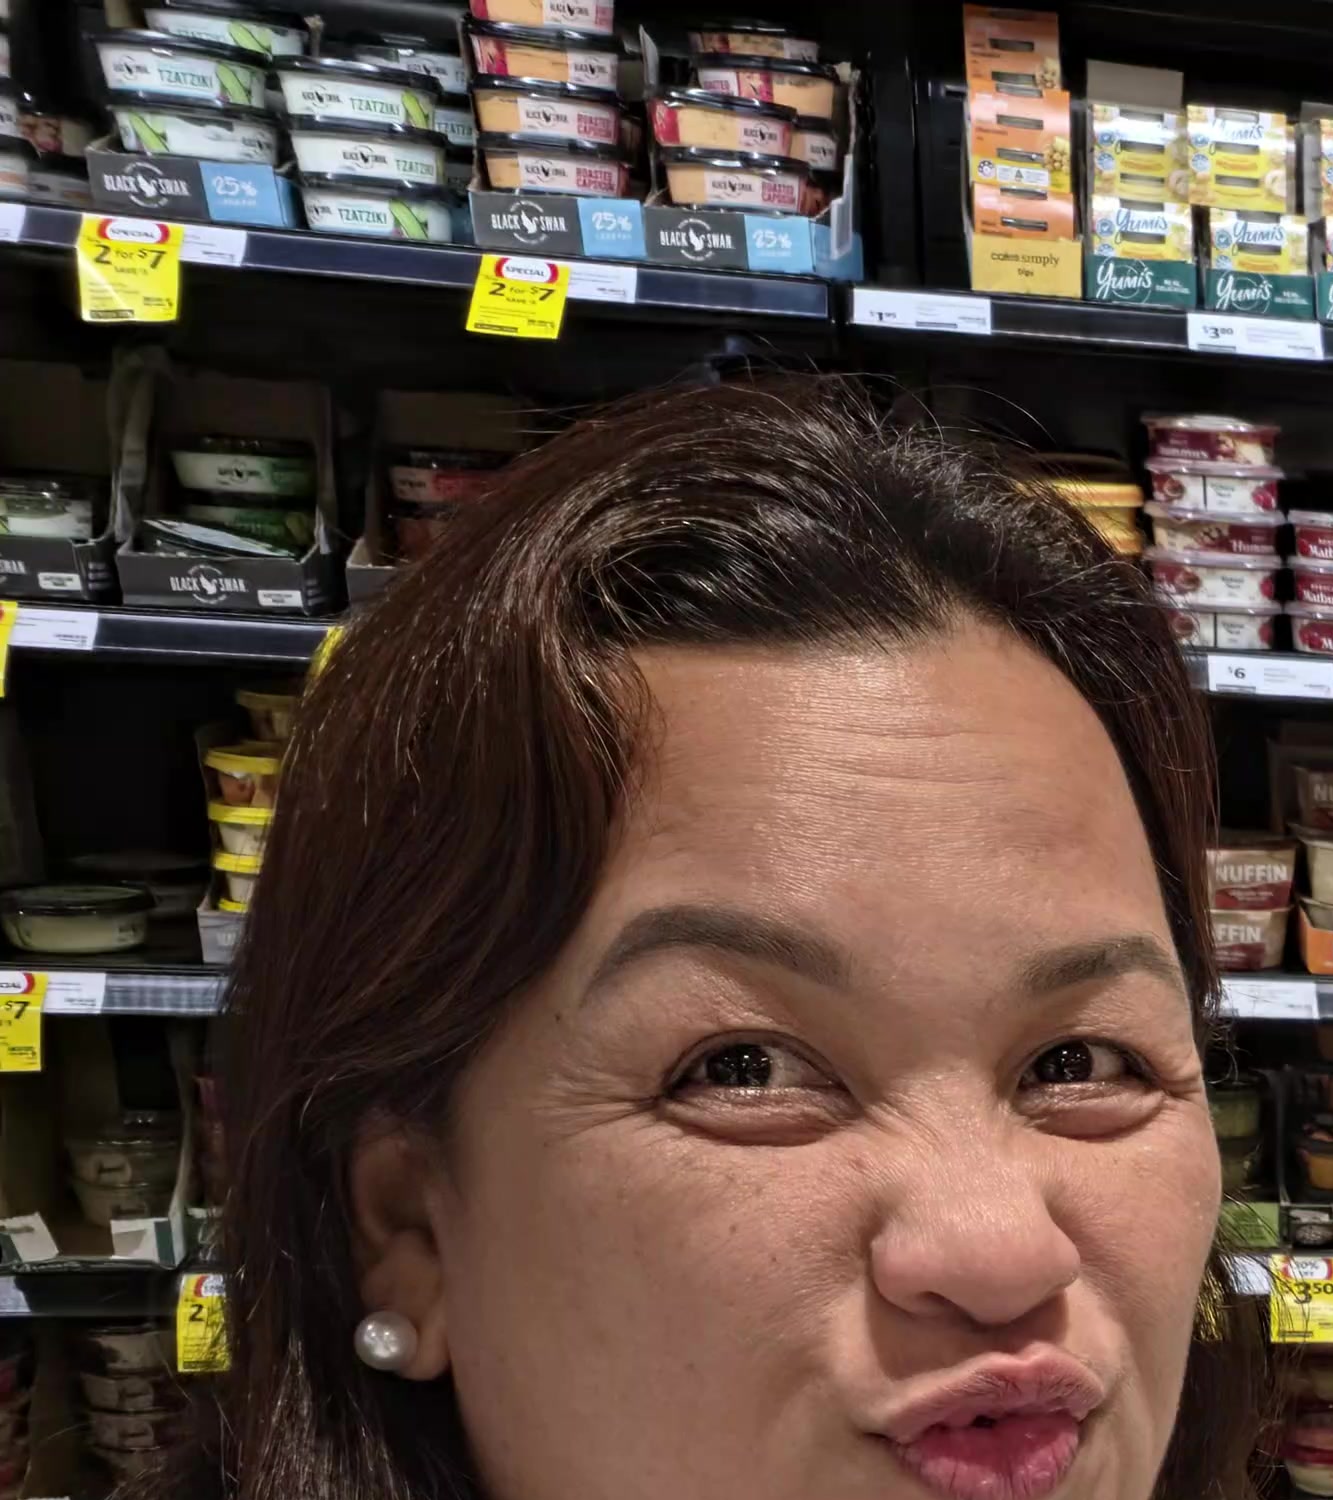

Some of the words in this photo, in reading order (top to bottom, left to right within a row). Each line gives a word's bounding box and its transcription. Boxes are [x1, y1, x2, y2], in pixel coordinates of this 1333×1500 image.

[157, 68, 214, 89] TZATZIKI
[350, 97, 401, 114] TZATZIKI
[103, 173, 141, 194] BLACK
[157, 176, 190, 197] SWAN
[338, 207, 388, 225] TZATZIKI
[491, 214, 521, 231] BLACK
[538, 216, 567, 232] SWAN
[660, 230, 689, 247] BLACK
[704, 233, 734, 250] SWAN
[94, 244, 112, 264] 2
[504, 264, 546, 279] SPECIAL
[488, 283, 506, 297] 2
[530, 286, 556, 302] $7
[169, 576, 200, 592] BLACK
[216, 578, 246, 592] SWAN
